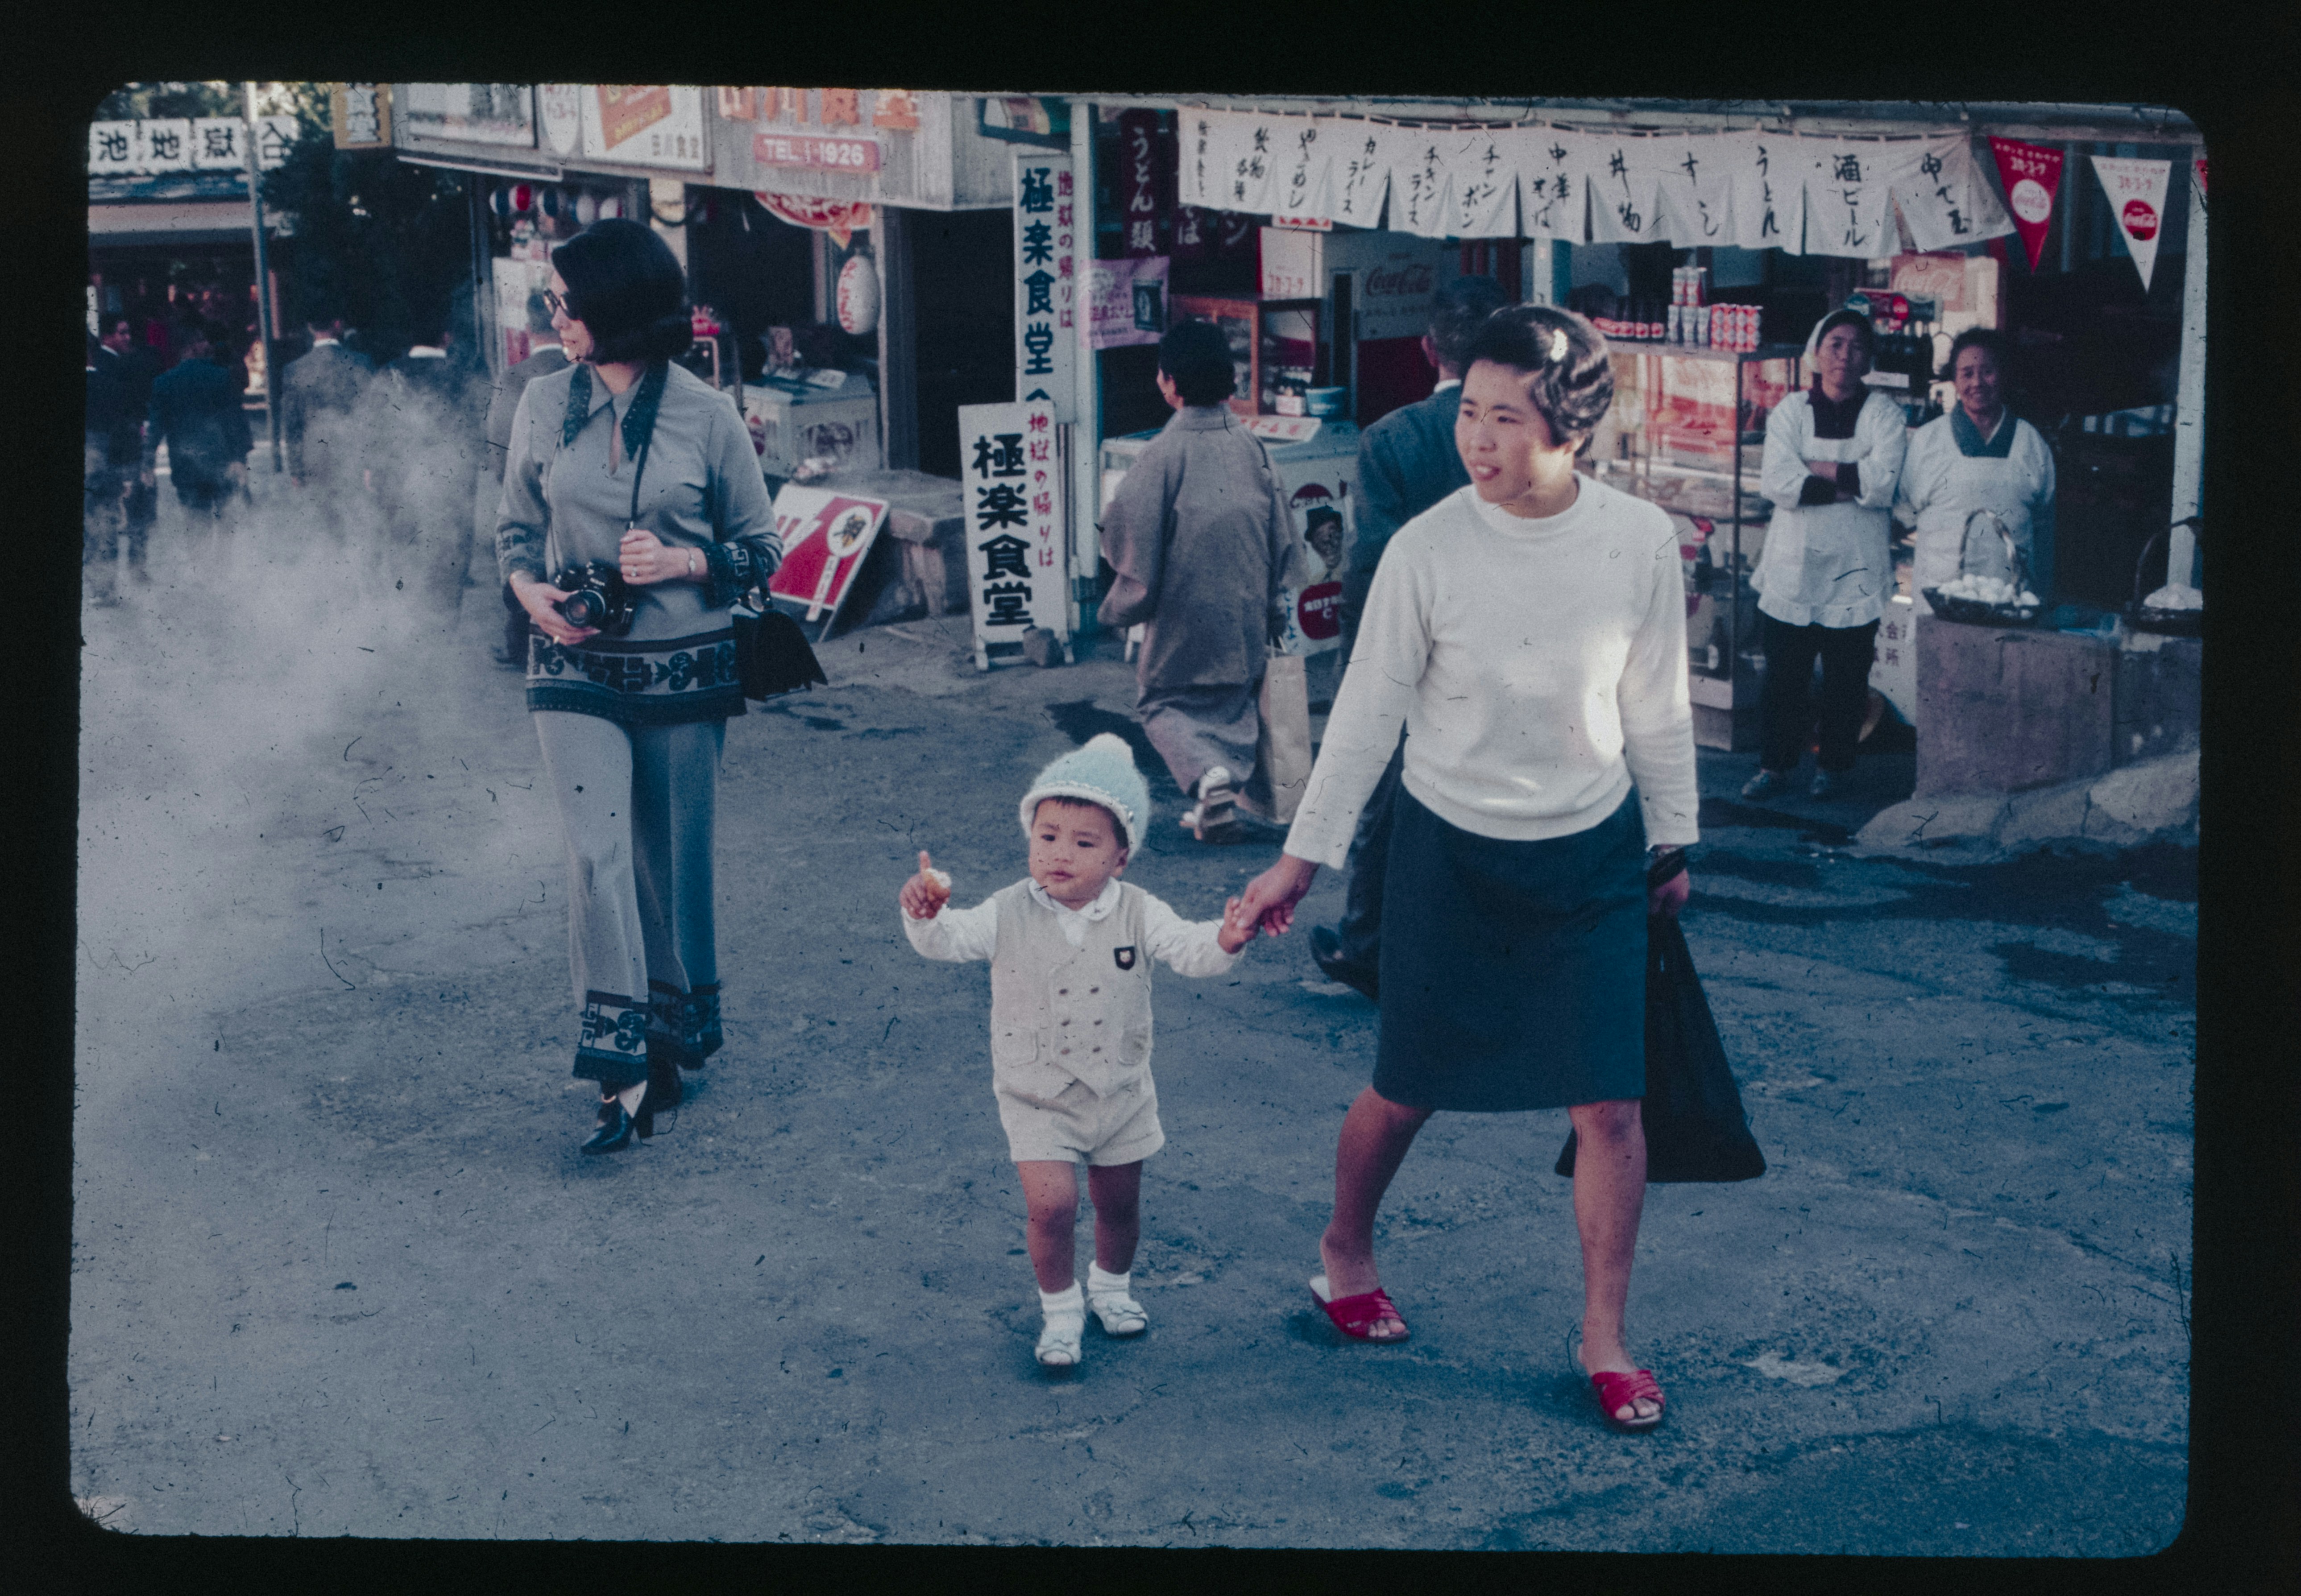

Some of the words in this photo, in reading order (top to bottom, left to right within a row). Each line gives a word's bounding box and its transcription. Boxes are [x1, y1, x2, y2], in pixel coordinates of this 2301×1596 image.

[1833, 153, 1866, 247] 酒ビール
[973, 433, 1037, 630] 極楽食堂
